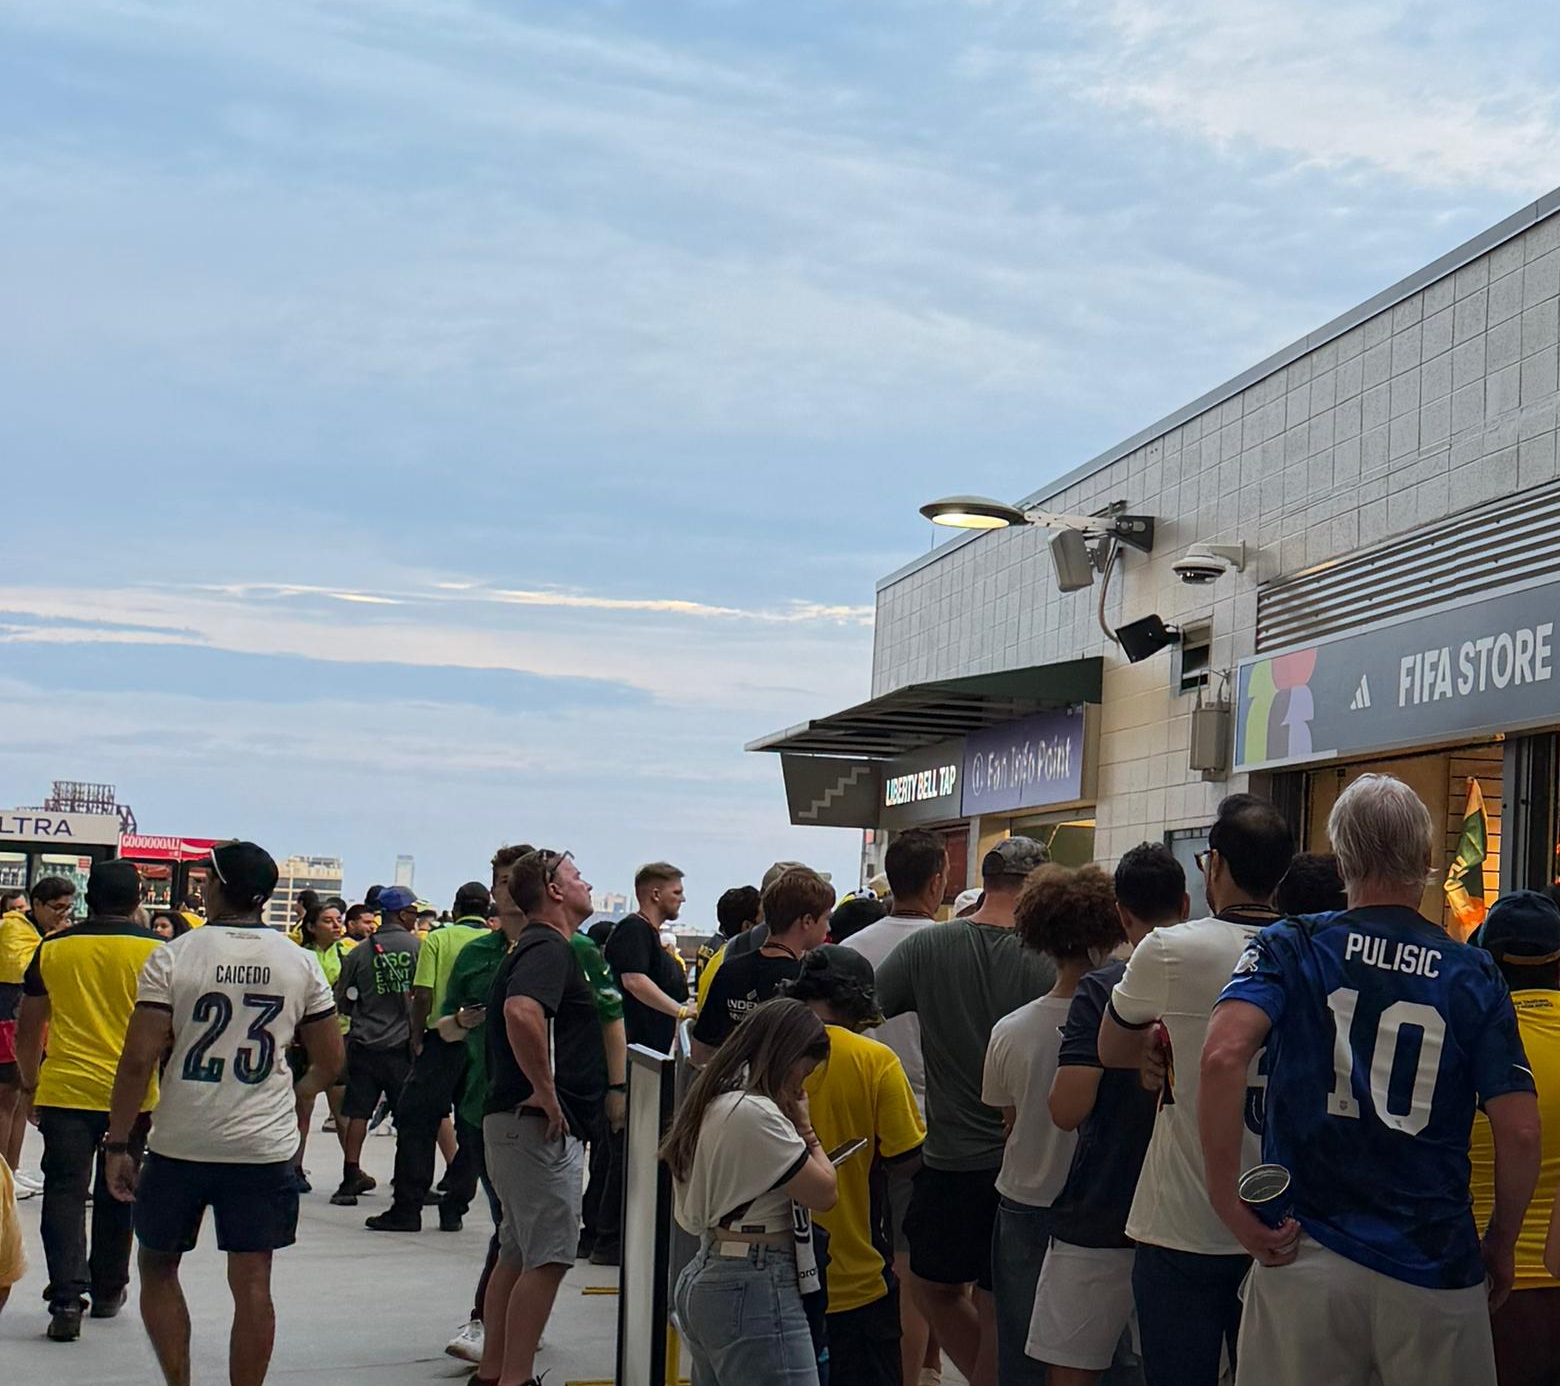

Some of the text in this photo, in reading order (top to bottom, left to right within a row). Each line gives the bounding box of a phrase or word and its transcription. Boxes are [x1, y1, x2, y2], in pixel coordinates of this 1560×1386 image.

[1399, 622, 1553, 707] FIFA STORE
[886, 764, 957, 806] LIBERTY BELL TAP
[987, 751, 1007, 791] Fan
[1037, 734, 1071, 782] Point
[0, 816, 72, 836] LTRA
[216, 965, 270, 985] CAICEDO
[376, 968, 409, 983] EENT
[1345, 932, 1442, 979] PULISIC
[182, 992, 285, 1085] 23
[1327, 987, 1446, 1136] 10
